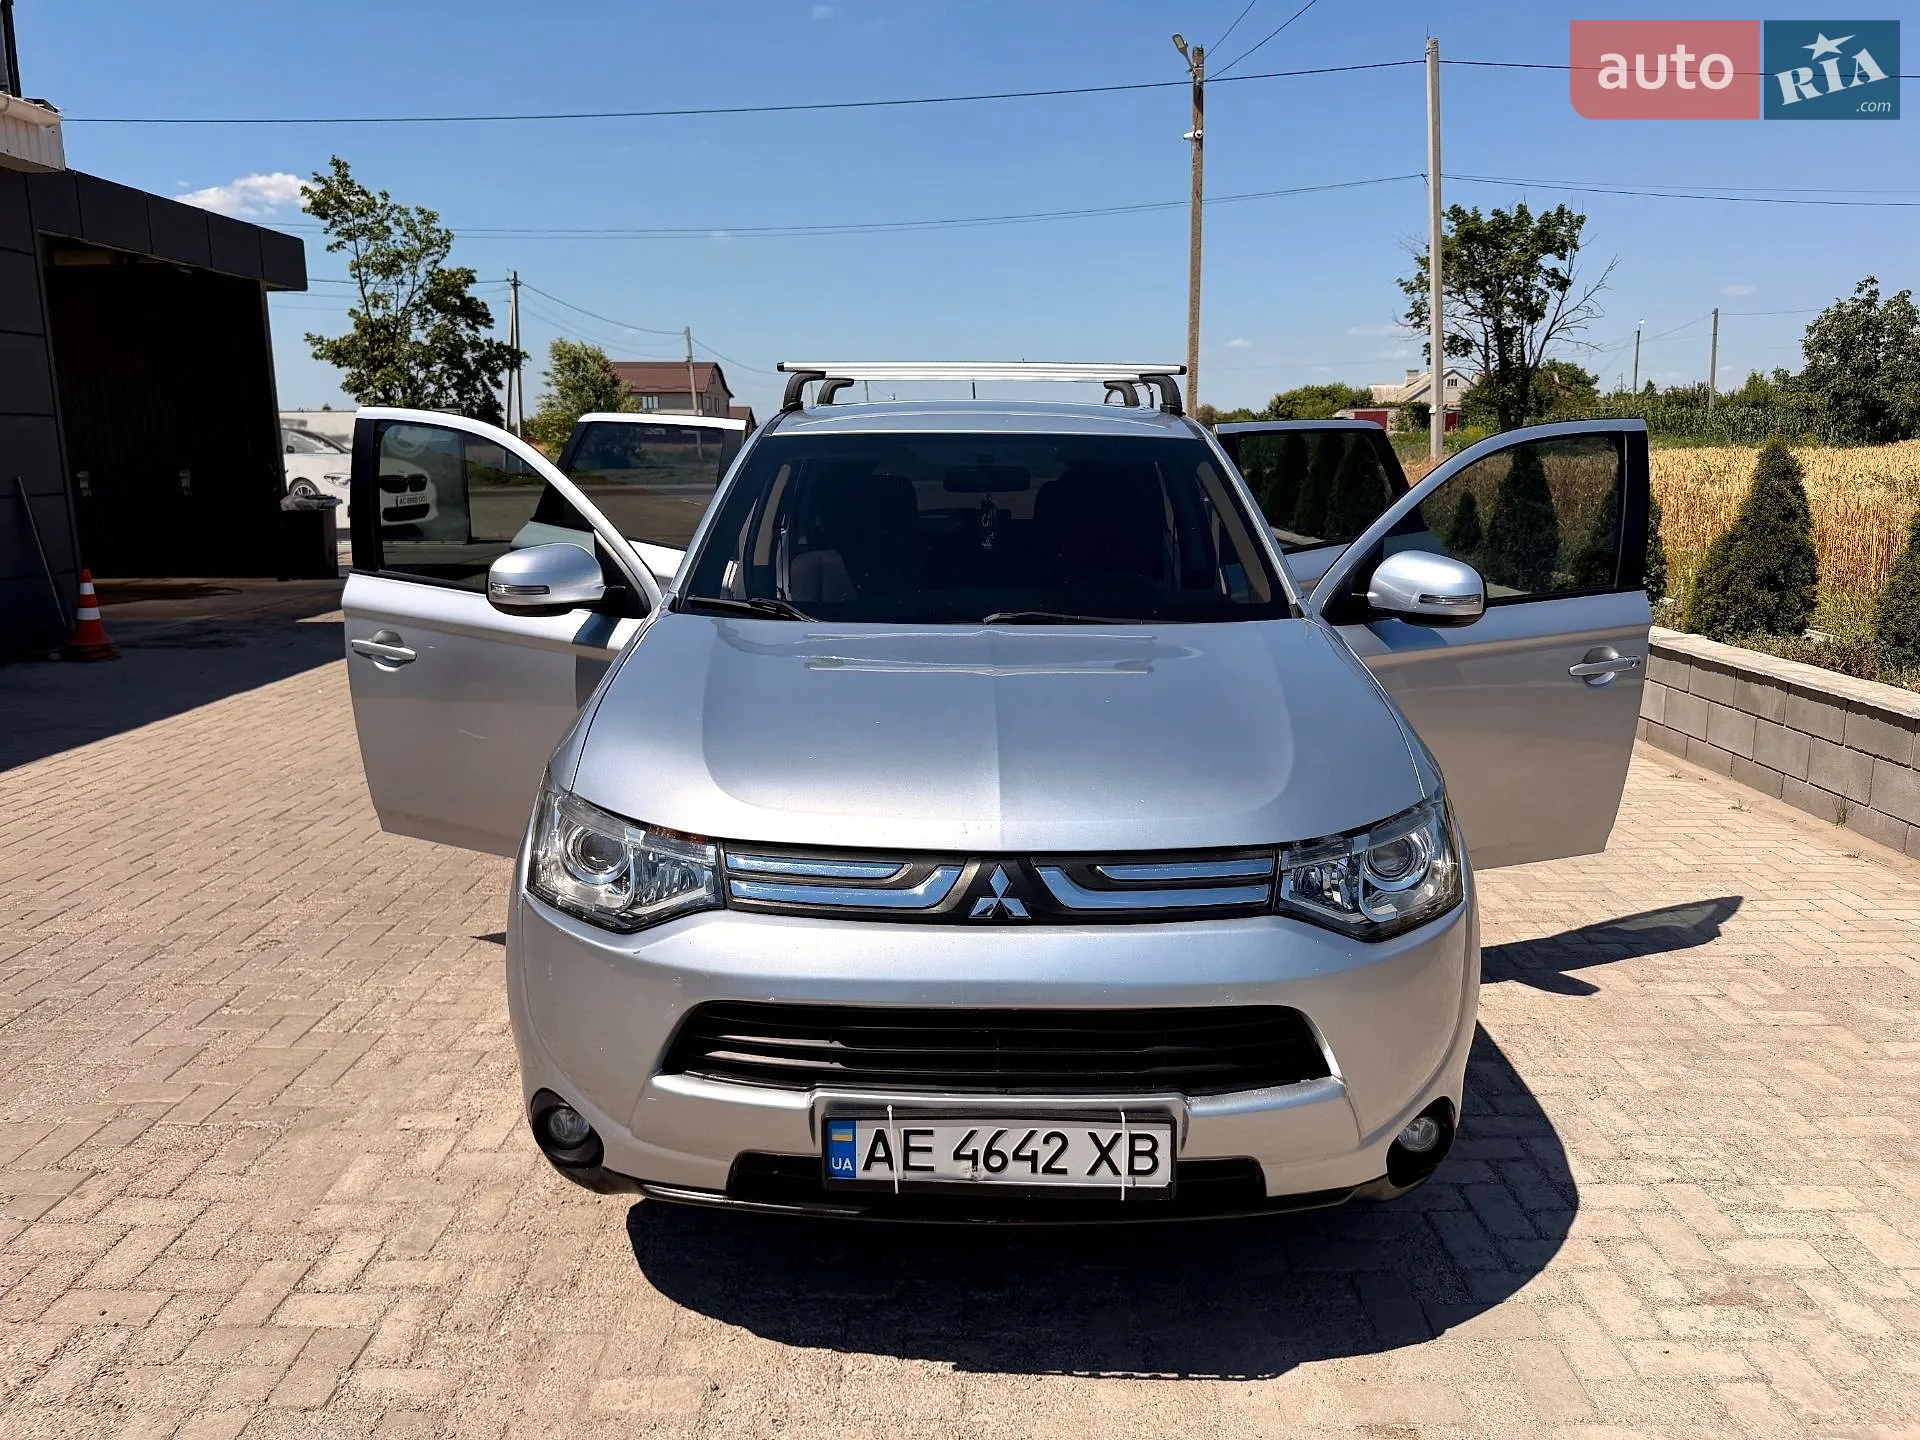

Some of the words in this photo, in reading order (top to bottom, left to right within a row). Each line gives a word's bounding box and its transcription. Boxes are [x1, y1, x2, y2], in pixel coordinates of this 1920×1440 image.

[831, 1157, 854, 1171] UA
[861, 1128, 935, 1172] AE
[952, 1129, 1069, 1175] 4642
[1085, 1131, 1159, 1177] XB
